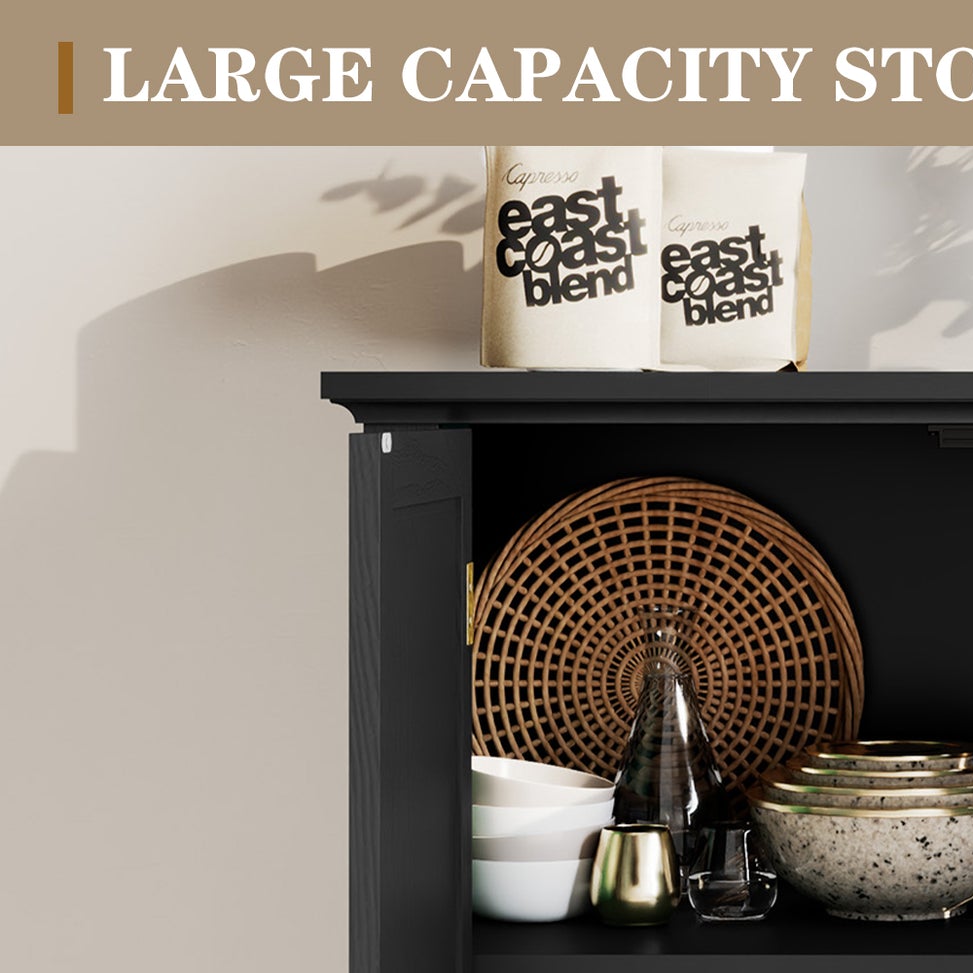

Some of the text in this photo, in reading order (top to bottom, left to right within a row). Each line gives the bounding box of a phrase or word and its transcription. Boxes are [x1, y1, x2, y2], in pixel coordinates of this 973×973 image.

[501, 163, 580, 192] Capresso
[498, 175, 624, 239] east
[665, 214, 730, 237] Capresso
[496, 207, 649, 278] coast
[660, 225, 766, 275] east
[522, 253, 635, 307] blend
[660, 249, 784, 303] coast
[682, 285, 775, 327] blend
